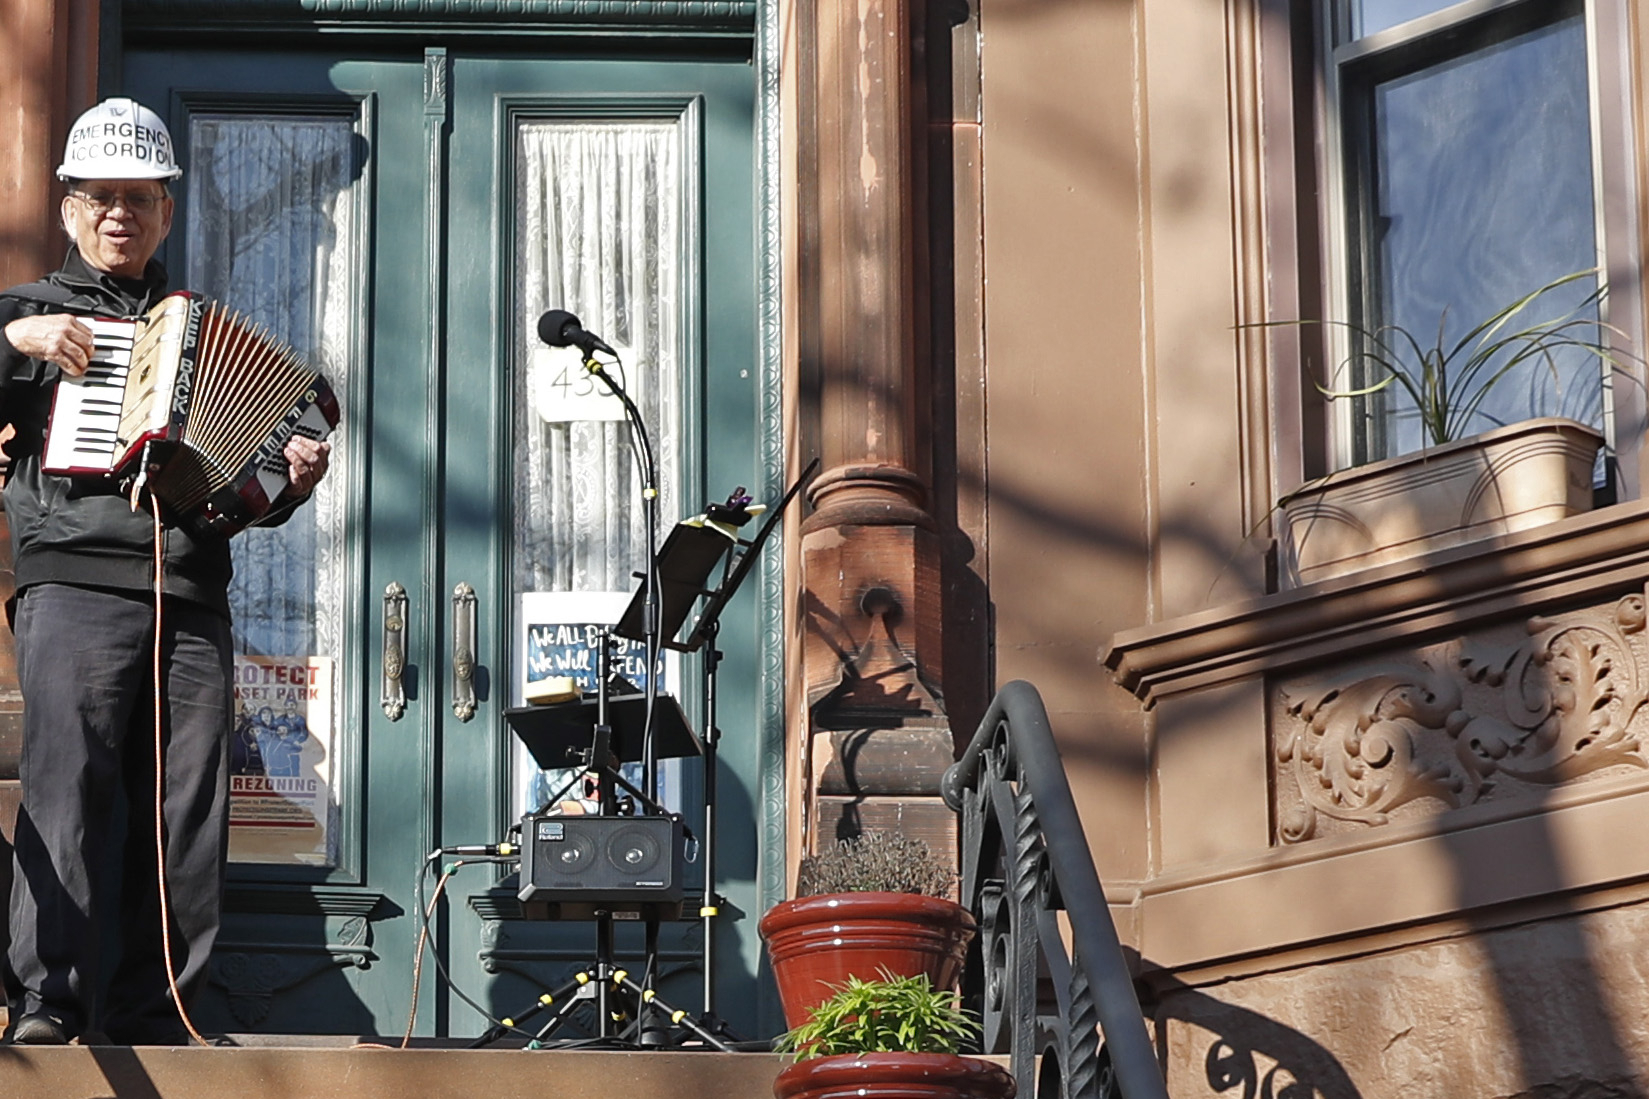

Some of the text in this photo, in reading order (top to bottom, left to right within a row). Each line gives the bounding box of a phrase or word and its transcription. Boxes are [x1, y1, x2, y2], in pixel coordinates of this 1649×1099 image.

[172, 298, 203, 415] KEEP BACK
[254, 389, 318, 464] 6 FEET
[532, 627, 554, 648] We
[556, 625, 585, 646] ALL
[529, 655, 553, 673] We
[555, 649, 592, 671] Will
[277, 687, 319, 700] PARK
[233, 778, 317, 791] REZONING
